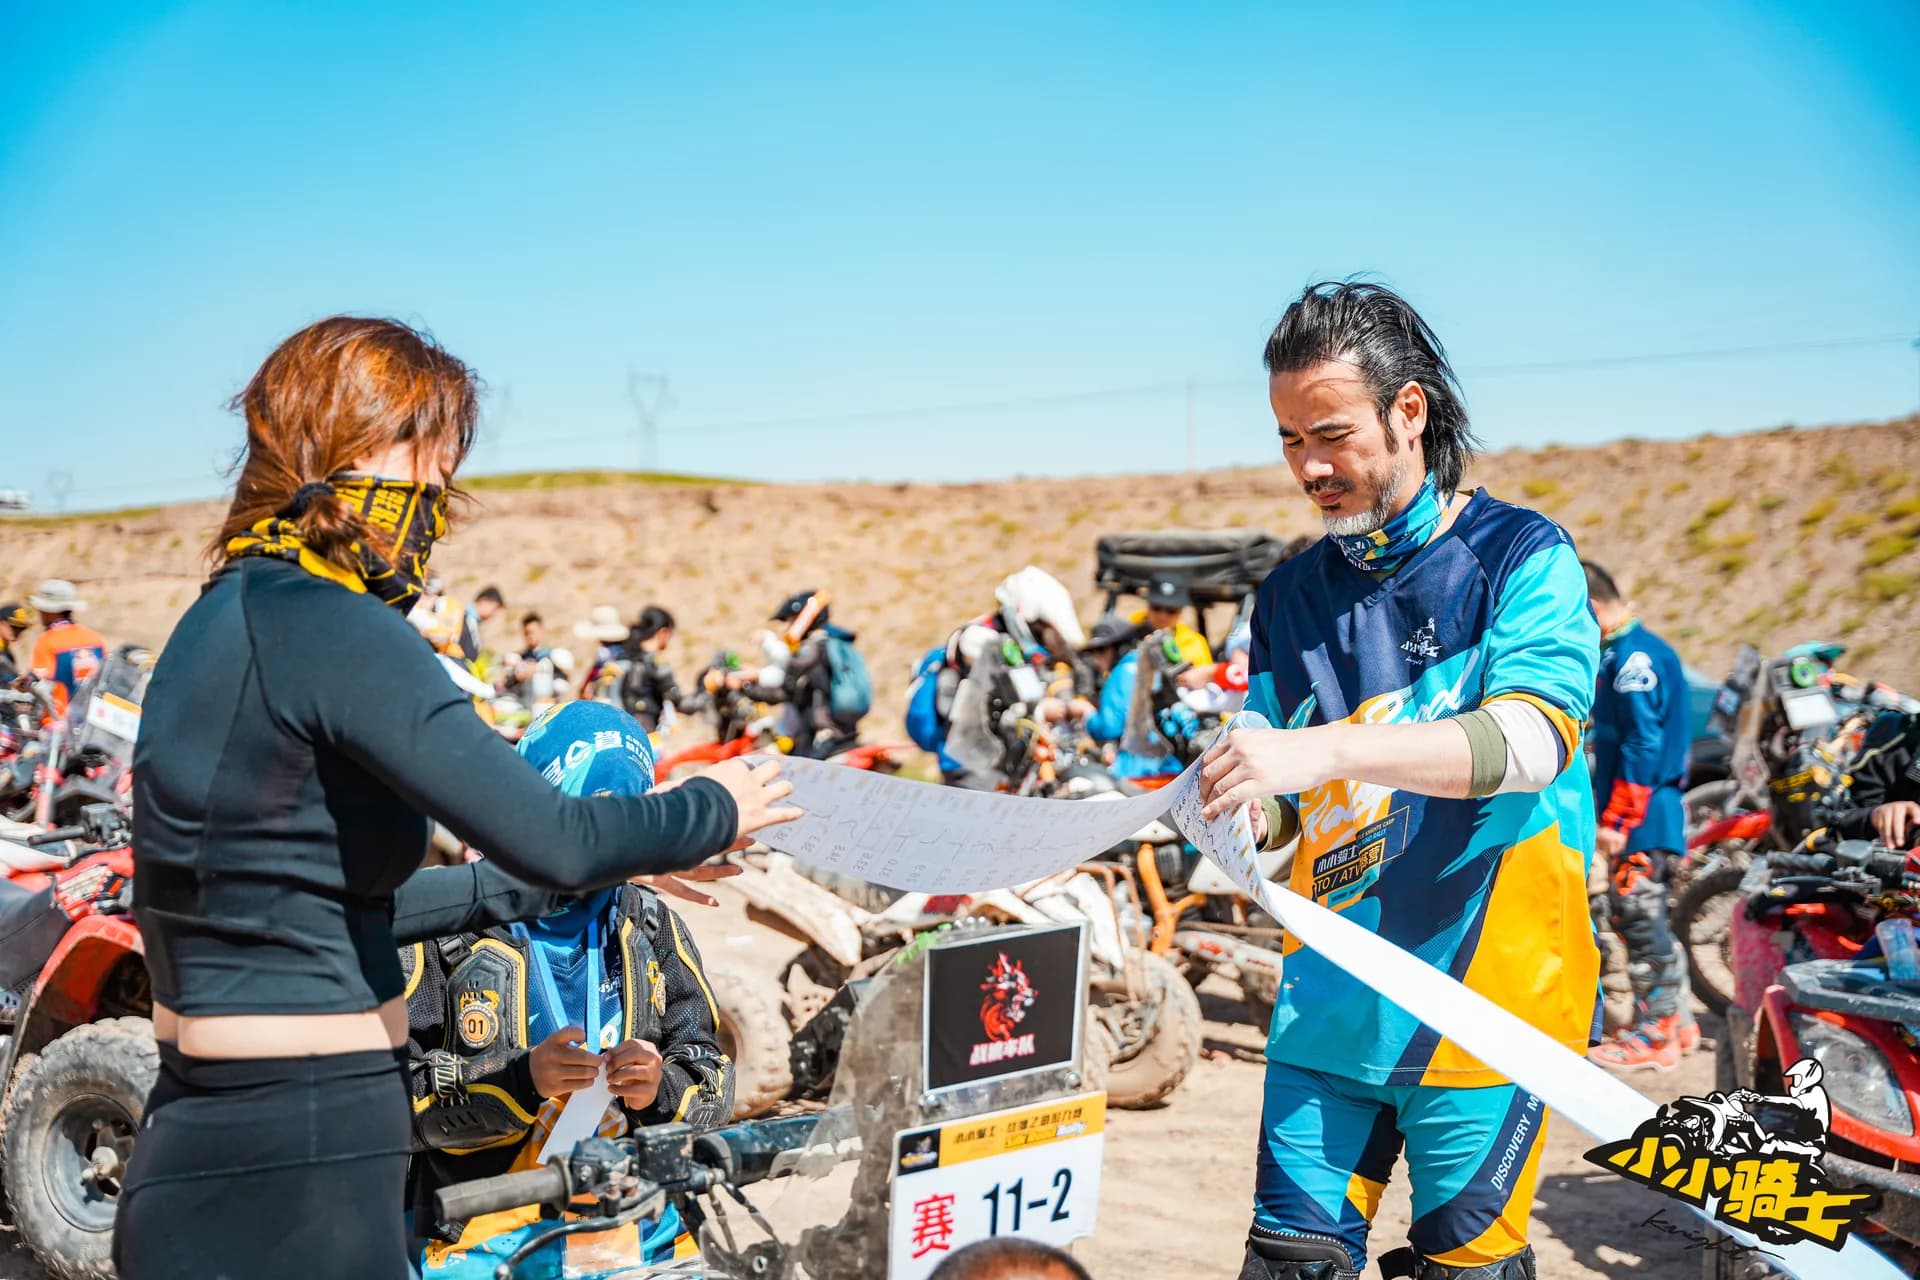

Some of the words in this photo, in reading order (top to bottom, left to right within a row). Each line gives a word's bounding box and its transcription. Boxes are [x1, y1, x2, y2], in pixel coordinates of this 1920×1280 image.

[468, 1018, 484, 1035] 01
[1490, 1113, 1531, 1191] DISCOVERY
[912, 1194, 955, 1259] 赛
[983, 1168, 1072, 1237] 11-2
